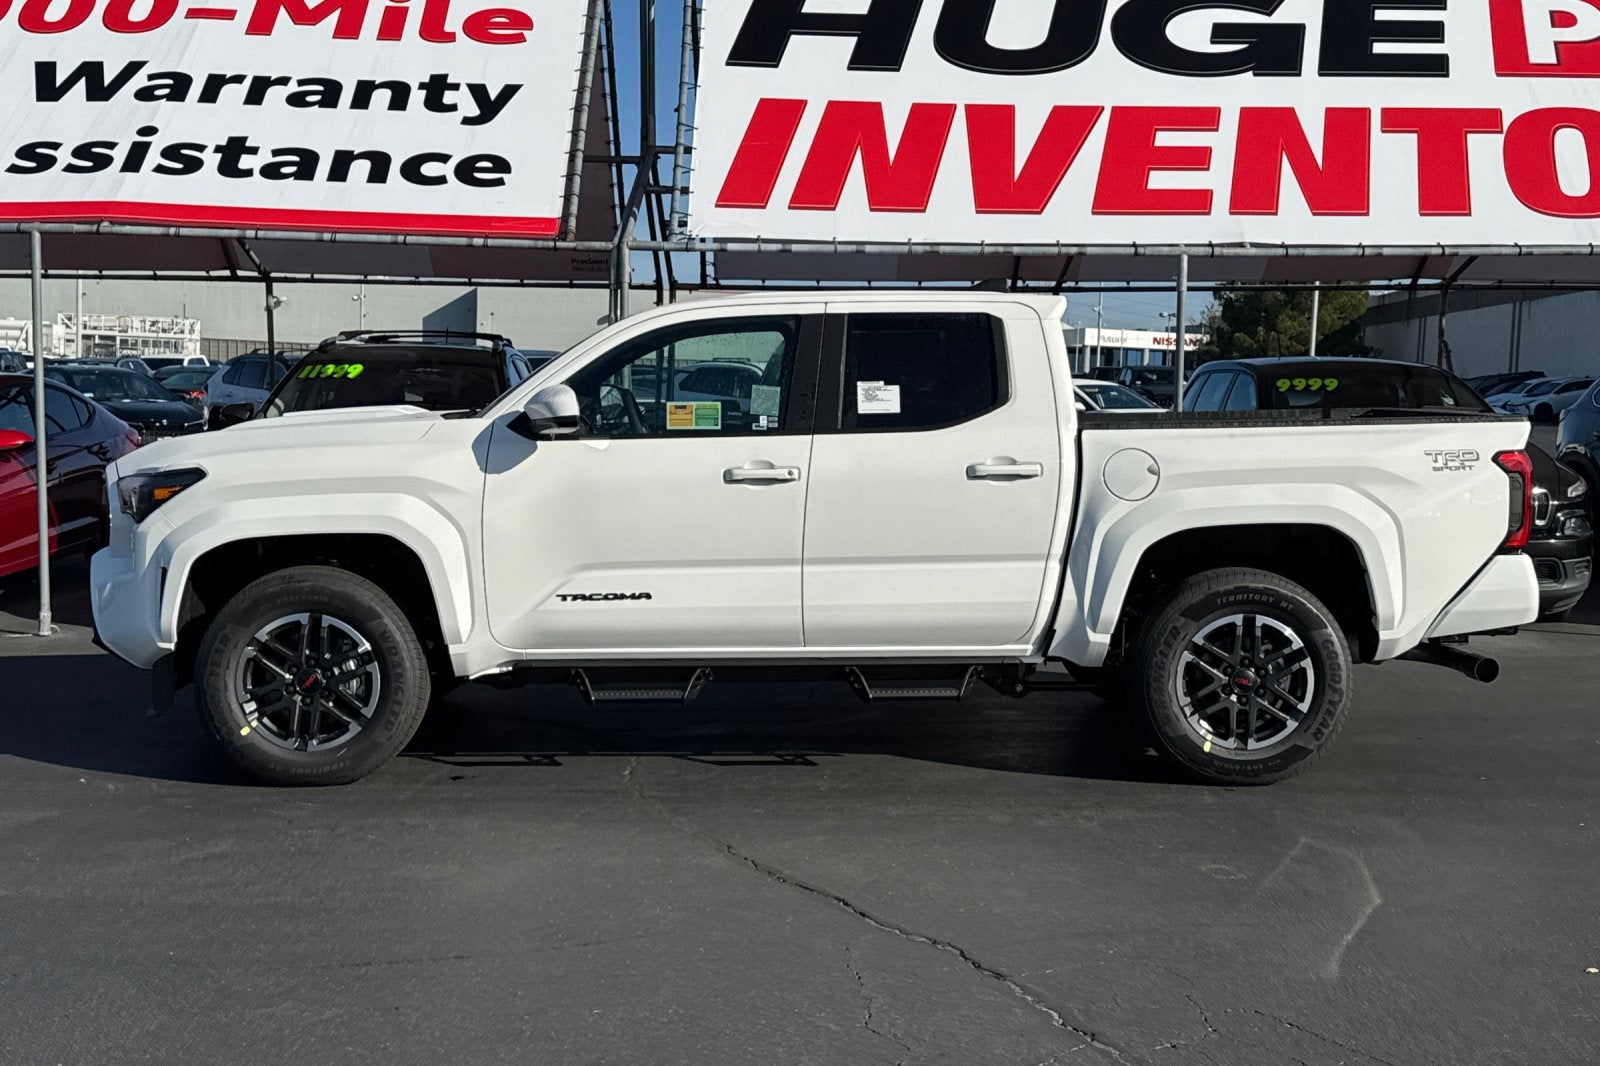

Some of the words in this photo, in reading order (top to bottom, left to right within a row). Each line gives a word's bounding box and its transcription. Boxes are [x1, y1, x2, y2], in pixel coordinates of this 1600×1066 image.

[0, 0, 534, 45] 00-Mile
[726, 0, 1450, 78] HUGE
[34, 60, 524, 127] Warranty
[4, 125, 512, 188] ssistance
[715, 98, 1600, 218] INVENTO
[1276, 378, 1339, 392] 9999
[1424, 449, 1480, 466] TRD
[556, 592, 652, 602] TACOMA
